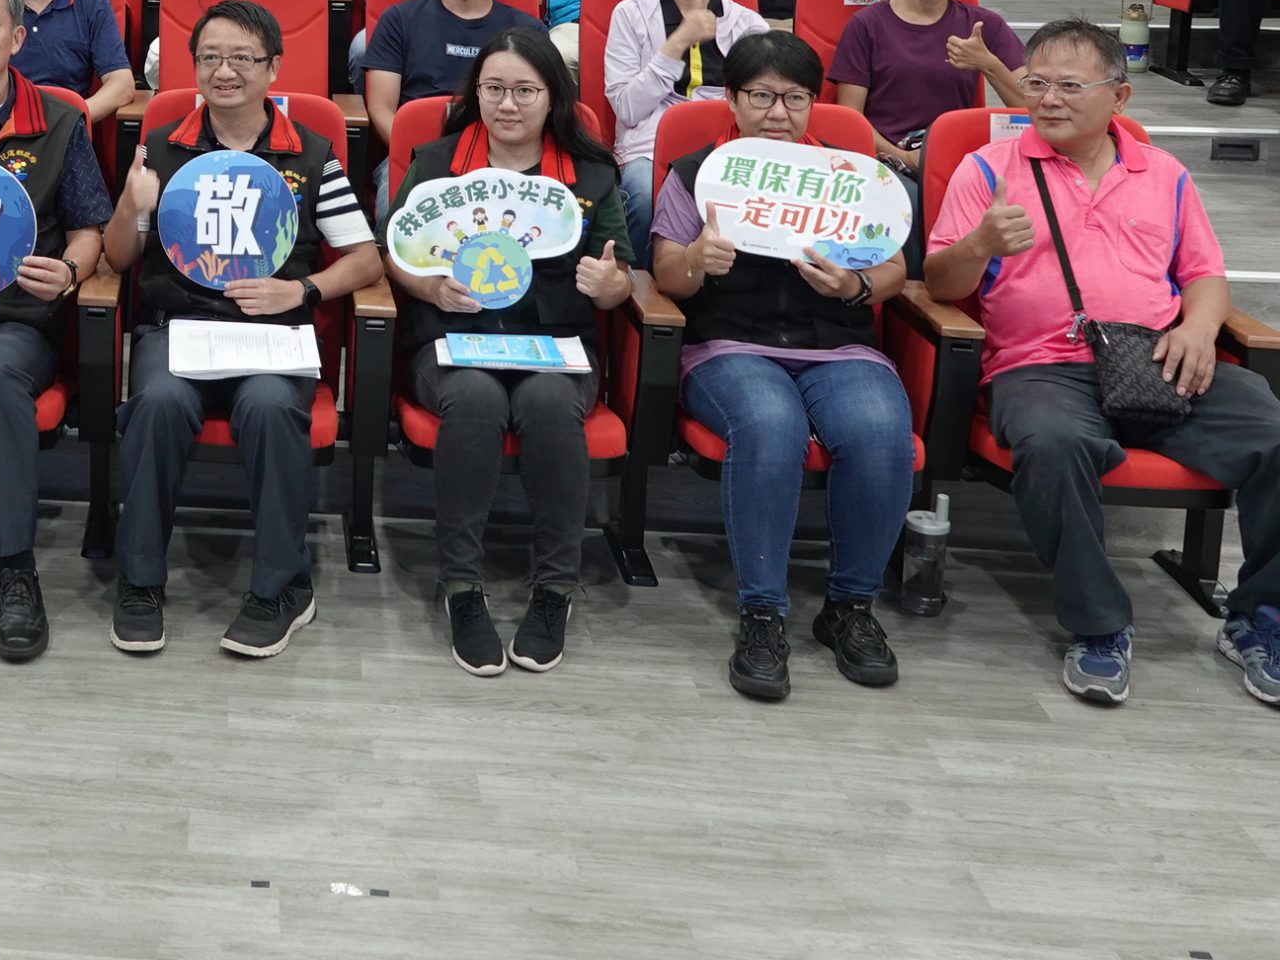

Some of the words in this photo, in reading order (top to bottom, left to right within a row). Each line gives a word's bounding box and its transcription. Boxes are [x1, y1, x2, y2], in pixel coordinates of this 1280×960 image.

[720, 156, 867, 205] 環保有你
[194, 174, 263, 256] 敬
[395, 178, 566, 238] 我是環保小尖兵
[713, 197, 862, 241] 一定可以!
